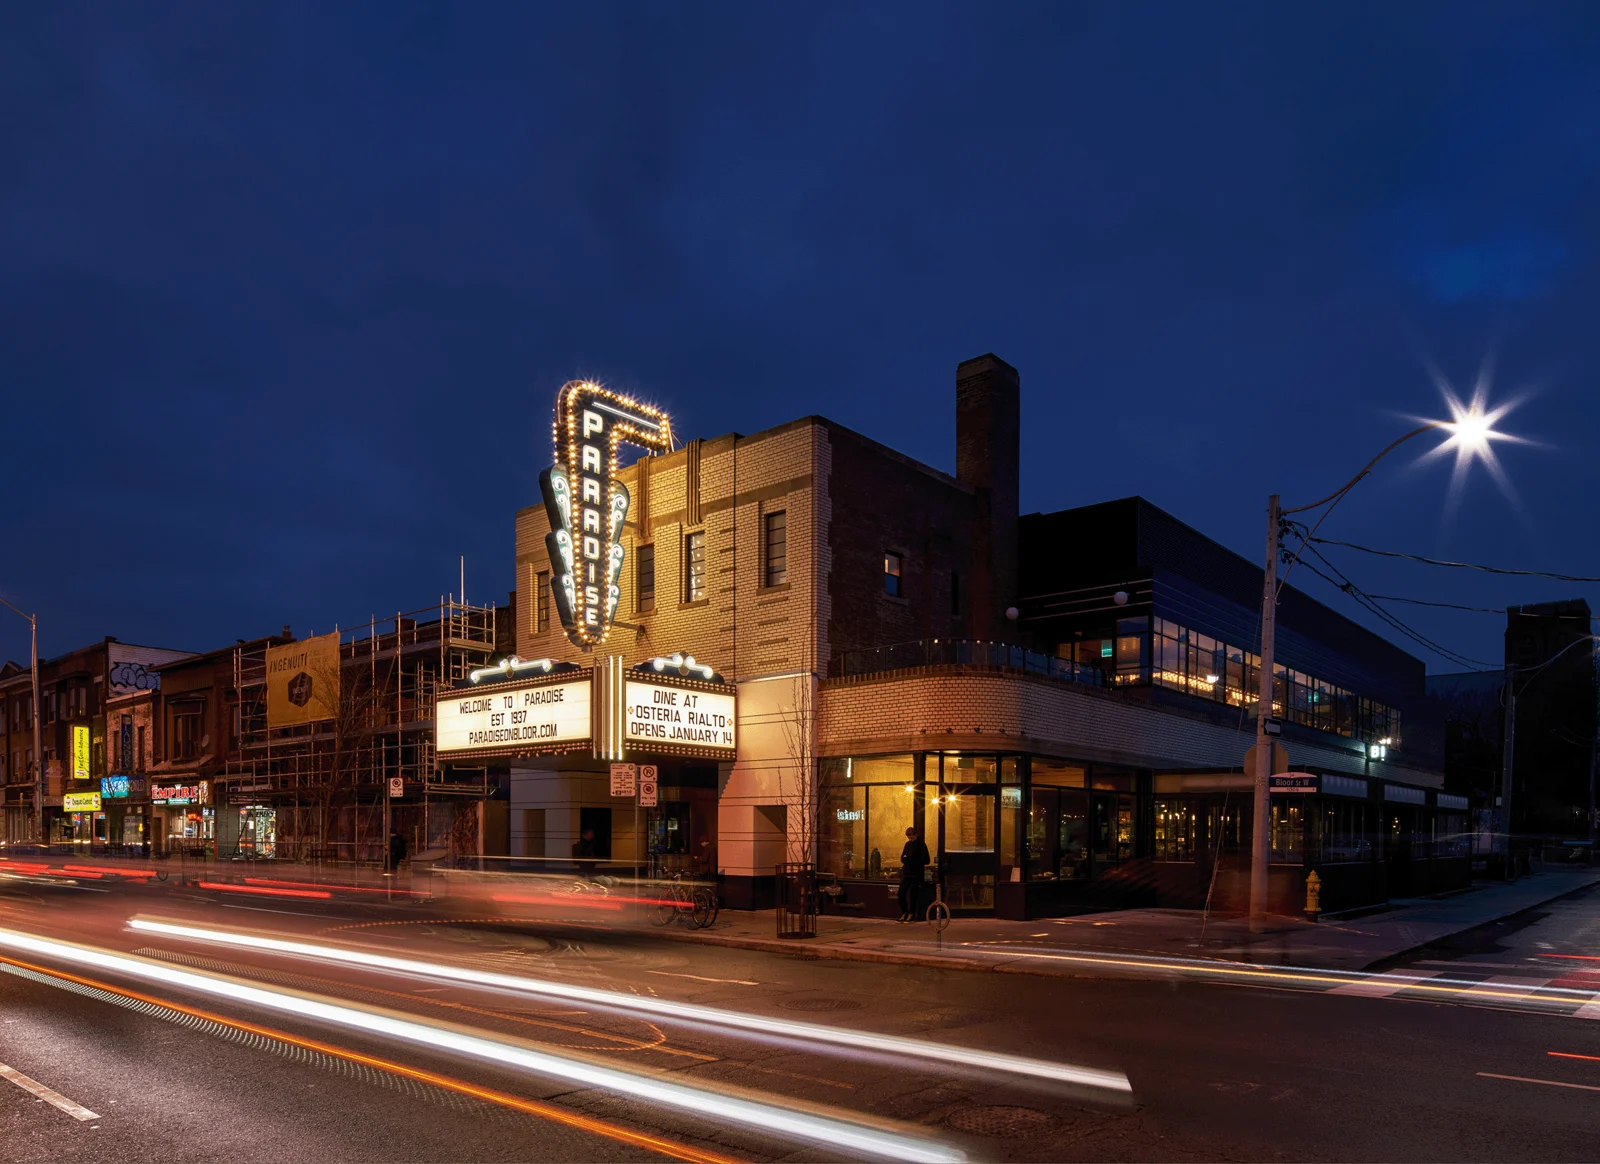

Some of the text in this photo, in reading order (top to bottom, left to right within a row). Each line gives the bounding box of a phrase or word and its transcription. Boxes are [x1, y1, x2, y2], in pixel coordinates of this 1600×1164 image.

[582, 408, 604, 627] PARADISE
[459, 689, 564, 714] WELCOME TO PARADISE
[654, 691, 698, 707] DINE AT
[491, 711, 527, 726] EST 1937
[636, 706, 725, 727] OSTERIA RIALTO
[469, 724, 557, 744] PARADISEONBLOOR.COM
[631, 722, 732, 744] OPENS JANUARY 14
[152, 786, 198, 799] EMPIRE
